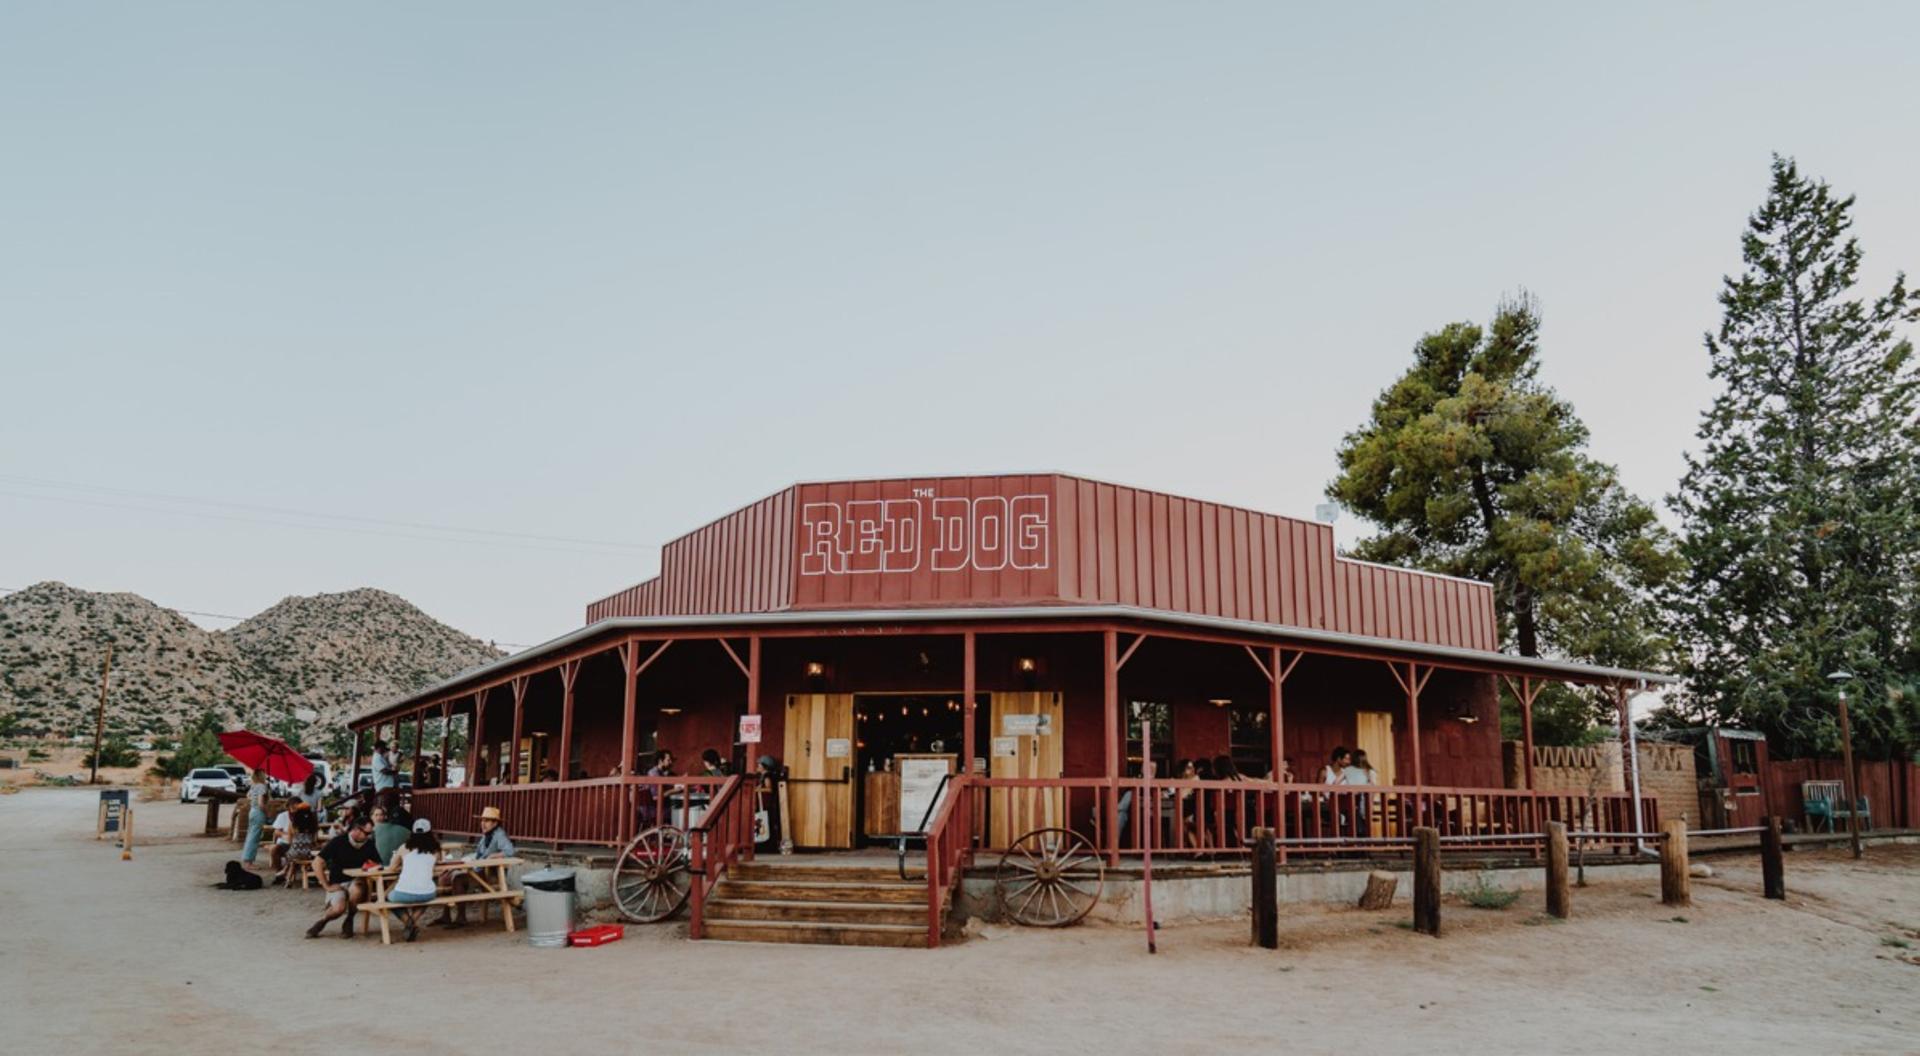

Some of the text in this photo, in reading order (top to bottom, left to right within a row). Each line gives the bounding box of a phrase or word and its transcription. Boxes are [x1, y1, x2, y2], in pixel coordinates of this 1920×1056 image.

[913, 488, 934, 498] THE
[801, 495, 1049, 575] RED DOG
